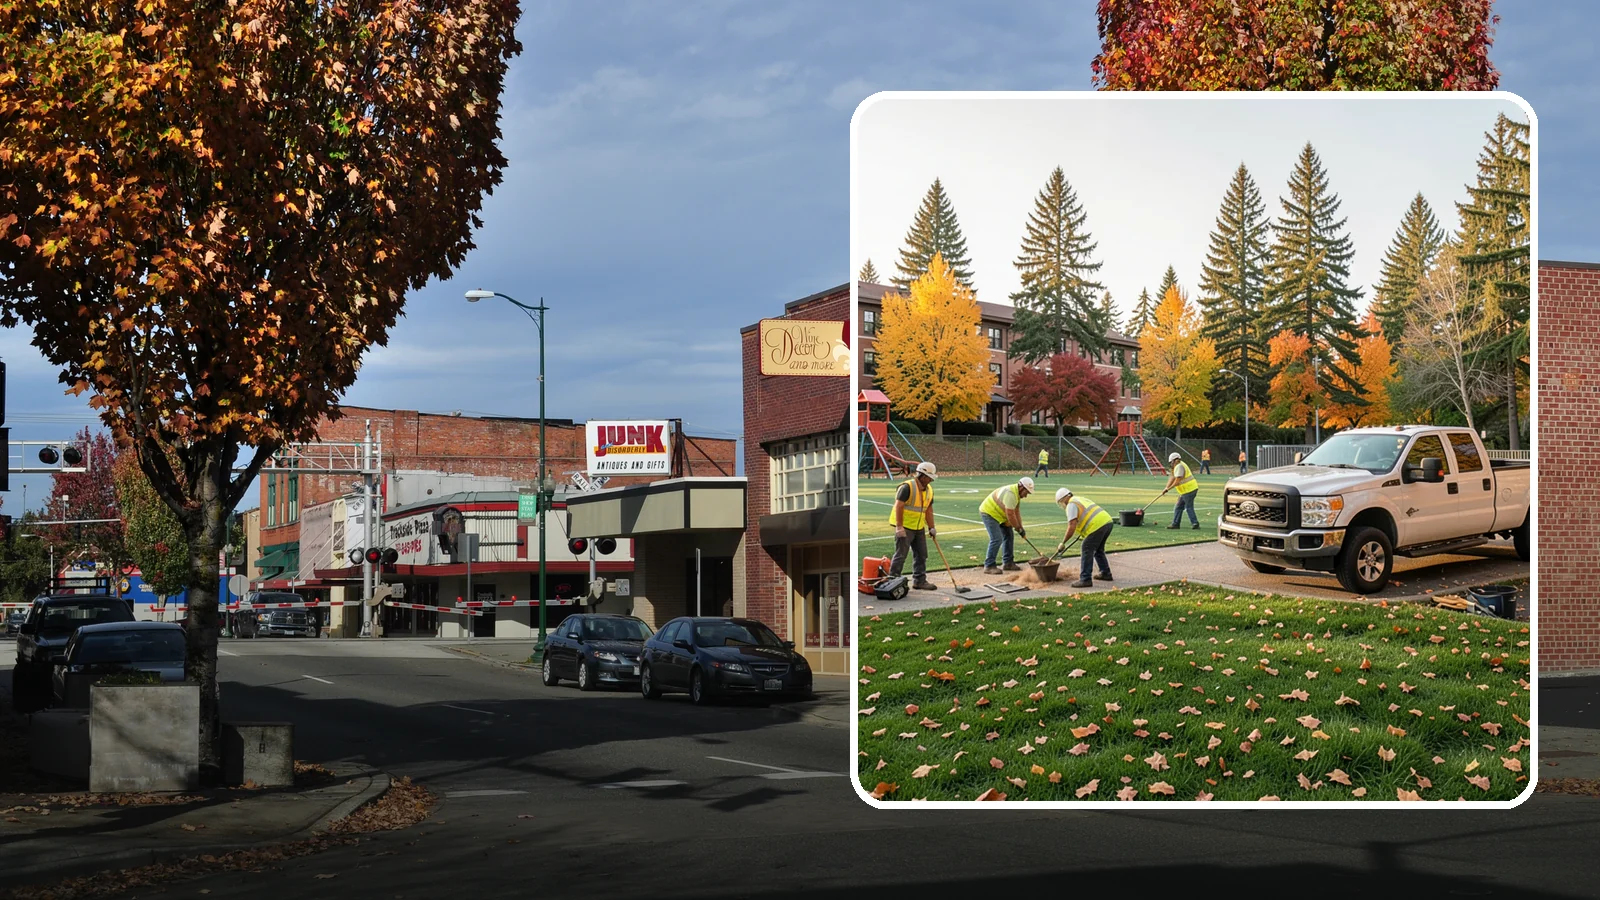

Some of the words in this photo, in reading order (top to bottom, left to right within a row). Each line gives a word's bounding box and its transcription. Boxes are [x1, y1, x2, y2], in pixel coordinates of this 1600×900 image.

[595, 425, 664, 457] JUNK
[607, 446, 646, 454] DISORDERLY
[597, 461, 628, 470] ANTIQUES
[631, 461, 644, 470] AND
[647, 461, 665, 469] GIFTS
[414, 519, 429, 534] Pizza
